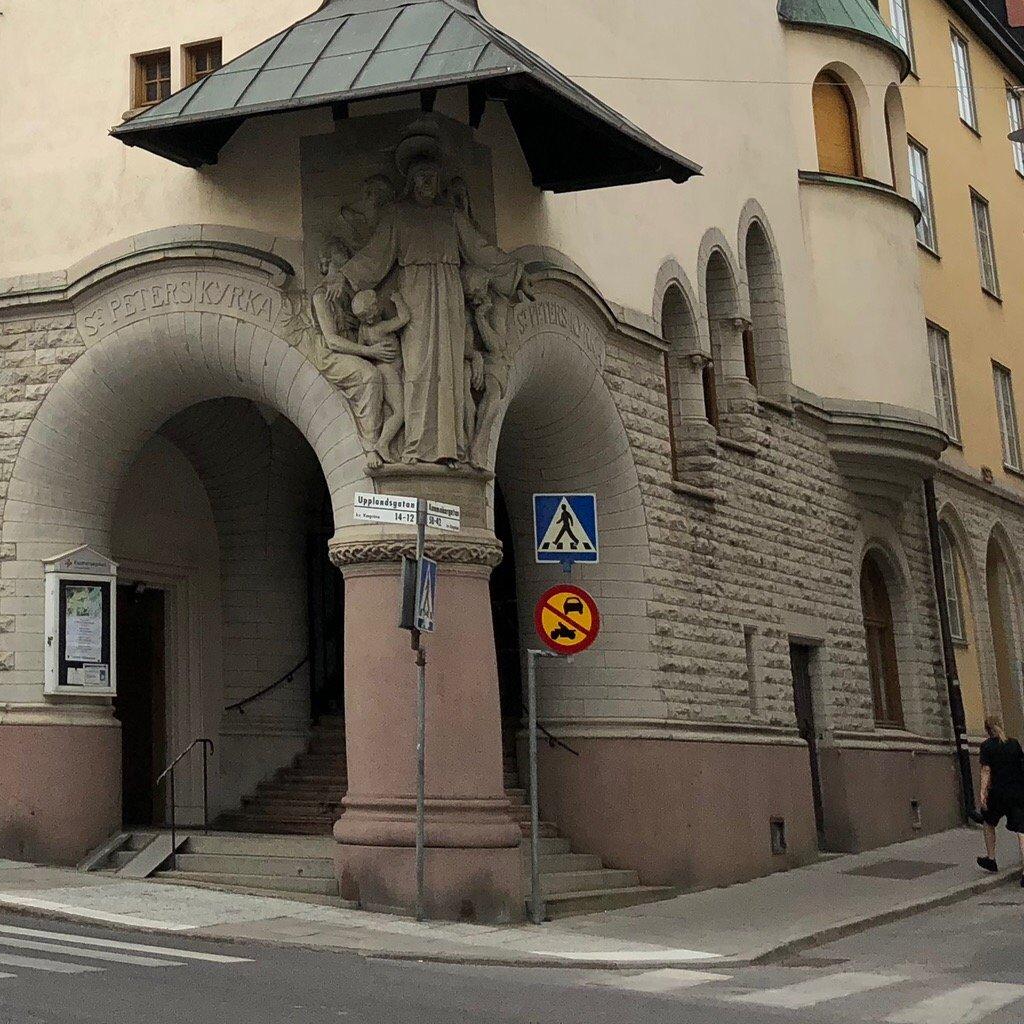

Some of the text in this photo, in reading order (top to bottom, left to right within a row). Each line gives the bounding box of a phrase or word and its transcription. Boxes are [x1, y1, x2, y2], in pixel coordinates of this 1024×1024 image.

[109, 281, 194, 323] PETERS
[198, 281, 273, 323] KYRKA
[357, 496, 415, 509] Upplandsgatan
[394, 512, 415, 523] 14-12
